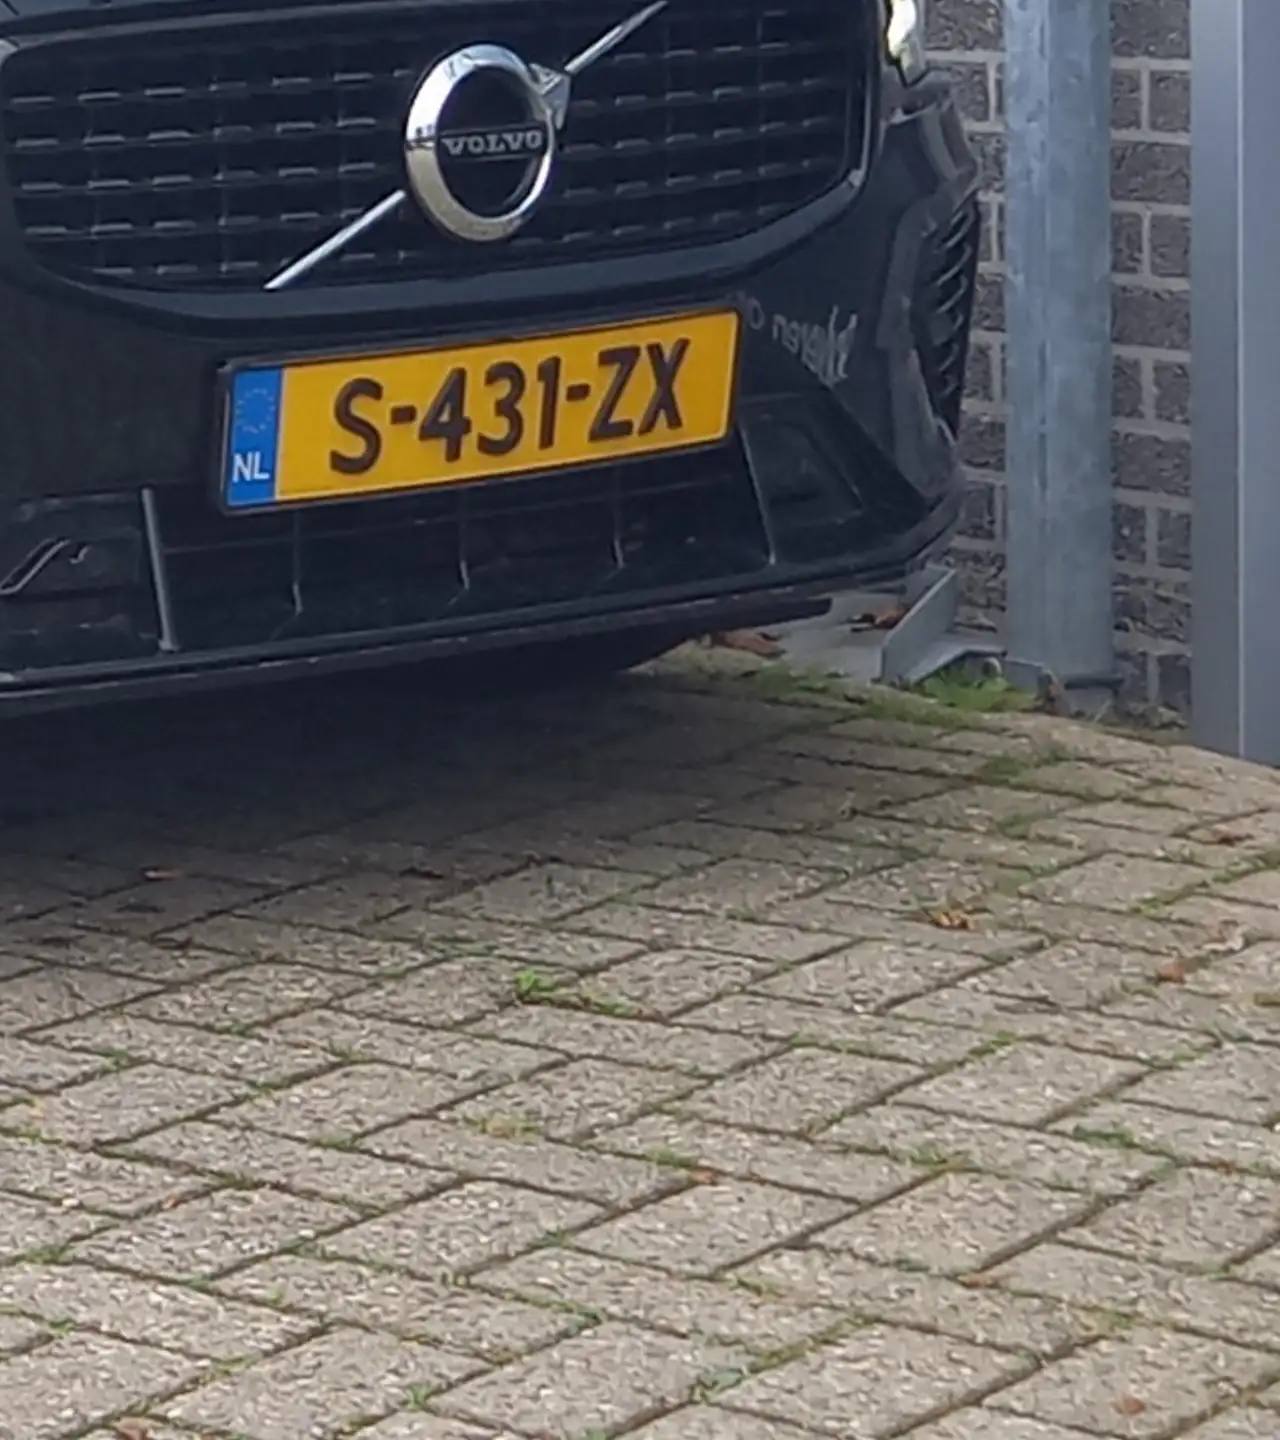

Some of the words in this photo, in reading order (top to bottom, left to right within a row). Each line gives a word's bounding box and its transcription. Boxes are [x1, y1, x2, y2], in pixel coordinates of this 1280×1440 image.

[442, 130, 542, 156] VOLVO
[330, 338, 691, 474] S-431-ZX
[232, 452, 271, 483] NL
